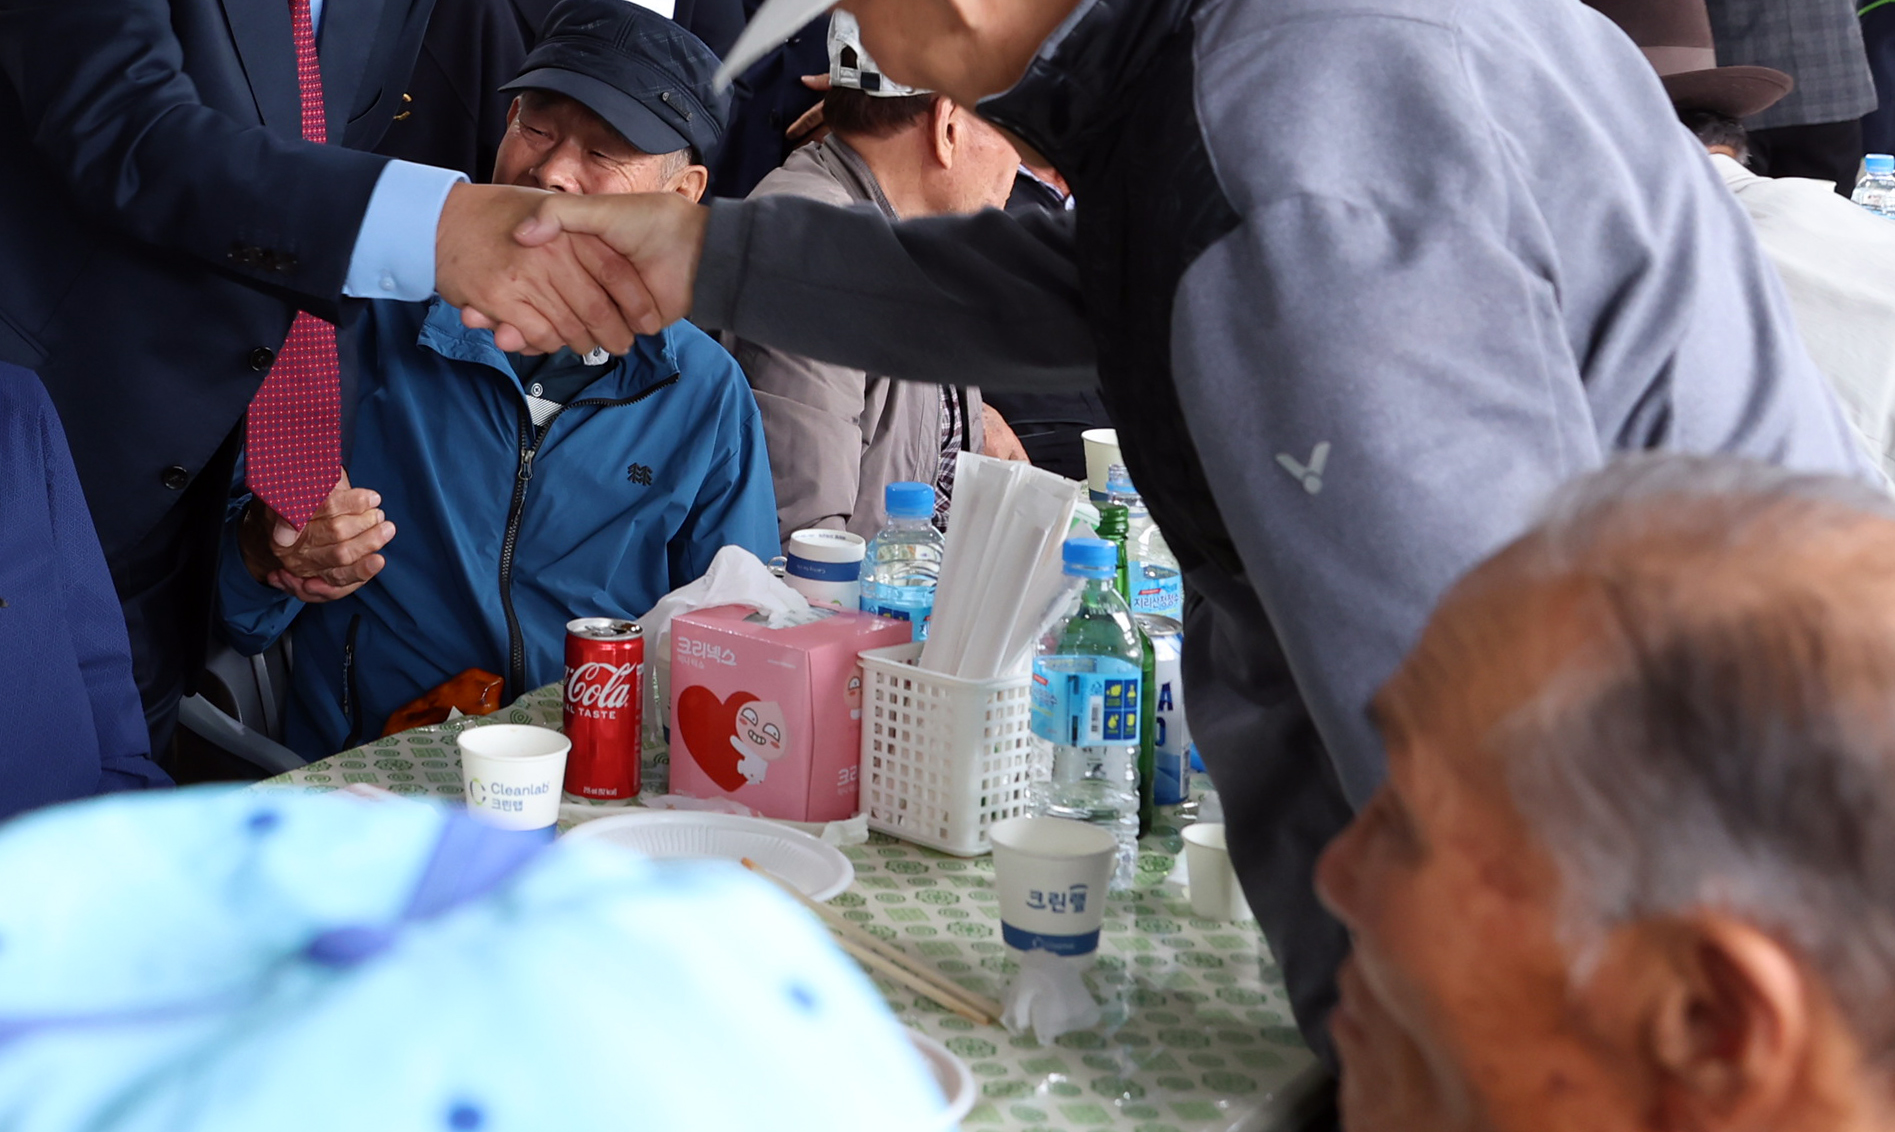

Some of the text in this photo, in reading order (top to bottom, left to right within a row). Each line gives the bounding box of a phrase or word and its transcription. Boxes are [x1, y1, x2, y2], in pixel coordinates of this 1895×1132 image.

[1134, 594, 1180, 609] 지리산청정수
[677, 636, 737, 666] 크리넥스
[568, 662, 637, 709] Cola
[578, 707, 616, 720] TASTE
[490, 782, 549, 796] Cleanlab
[1026, 883, 1088, 914] 크린랩
